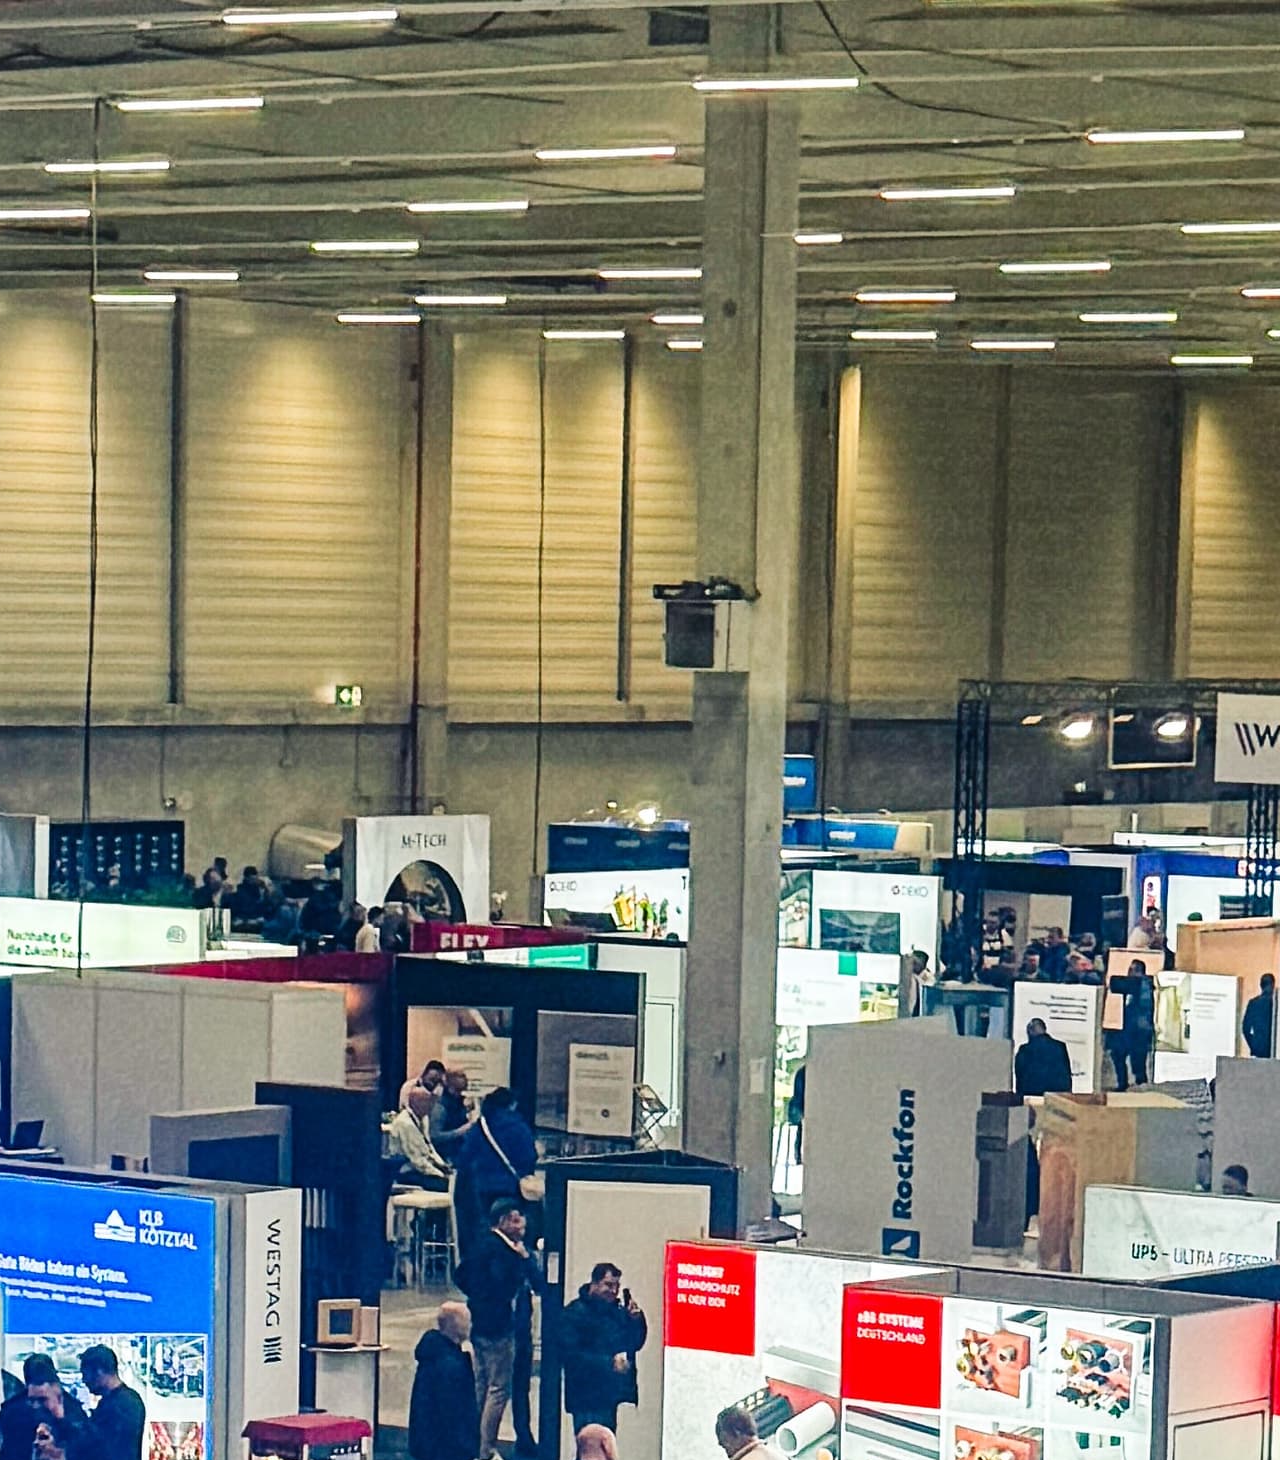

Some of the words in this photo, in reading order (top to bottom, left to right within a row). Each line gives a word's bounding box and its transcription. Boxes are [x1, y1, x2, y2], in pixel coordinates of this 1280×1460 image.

[401, 833, 447, 848] M-TECH
[892, 1089, 916, 1219] Rockfon
[139, 1209, 164, 1226] KLB
[139, 1226, 198, 1250] KÖTZTAL
[1174, 1248, 1213, 1266] ULTRA
[266, 1218, 281, 1327] WESTAG
[857, 1327, 926, 1344] DEUTSCHLAND
